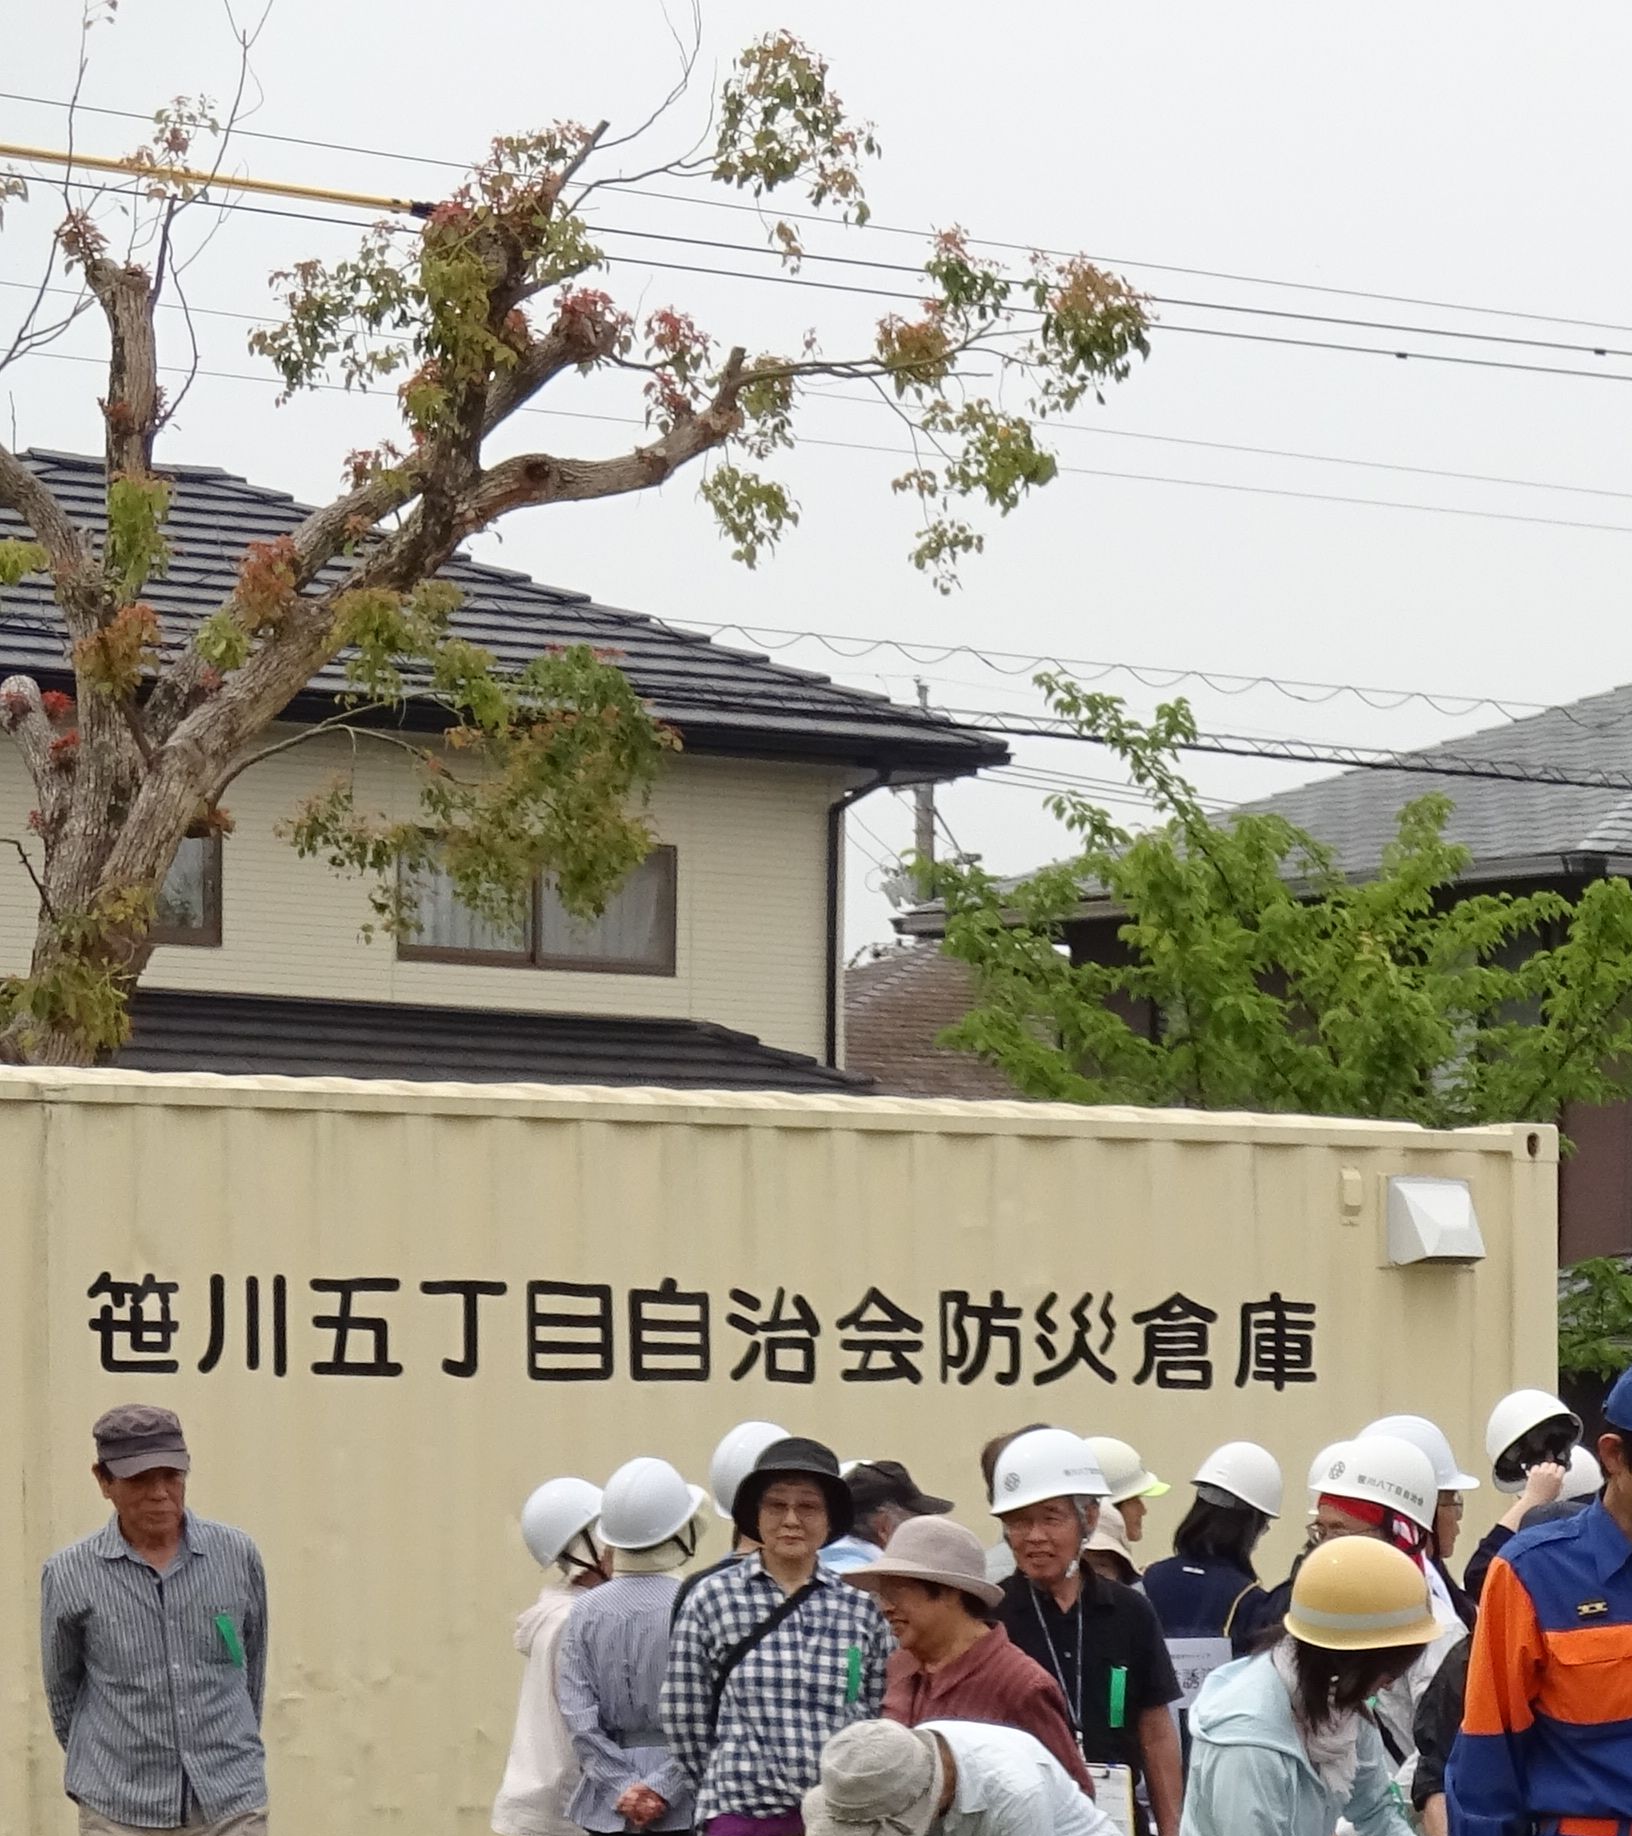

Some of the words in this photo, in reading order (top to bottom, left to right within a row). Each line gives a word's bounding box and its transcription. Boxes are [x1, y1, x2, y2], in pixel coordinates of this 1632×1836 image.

[87, 1271, 1318, 1391] 笹川五丁目自治会防災倉庫
